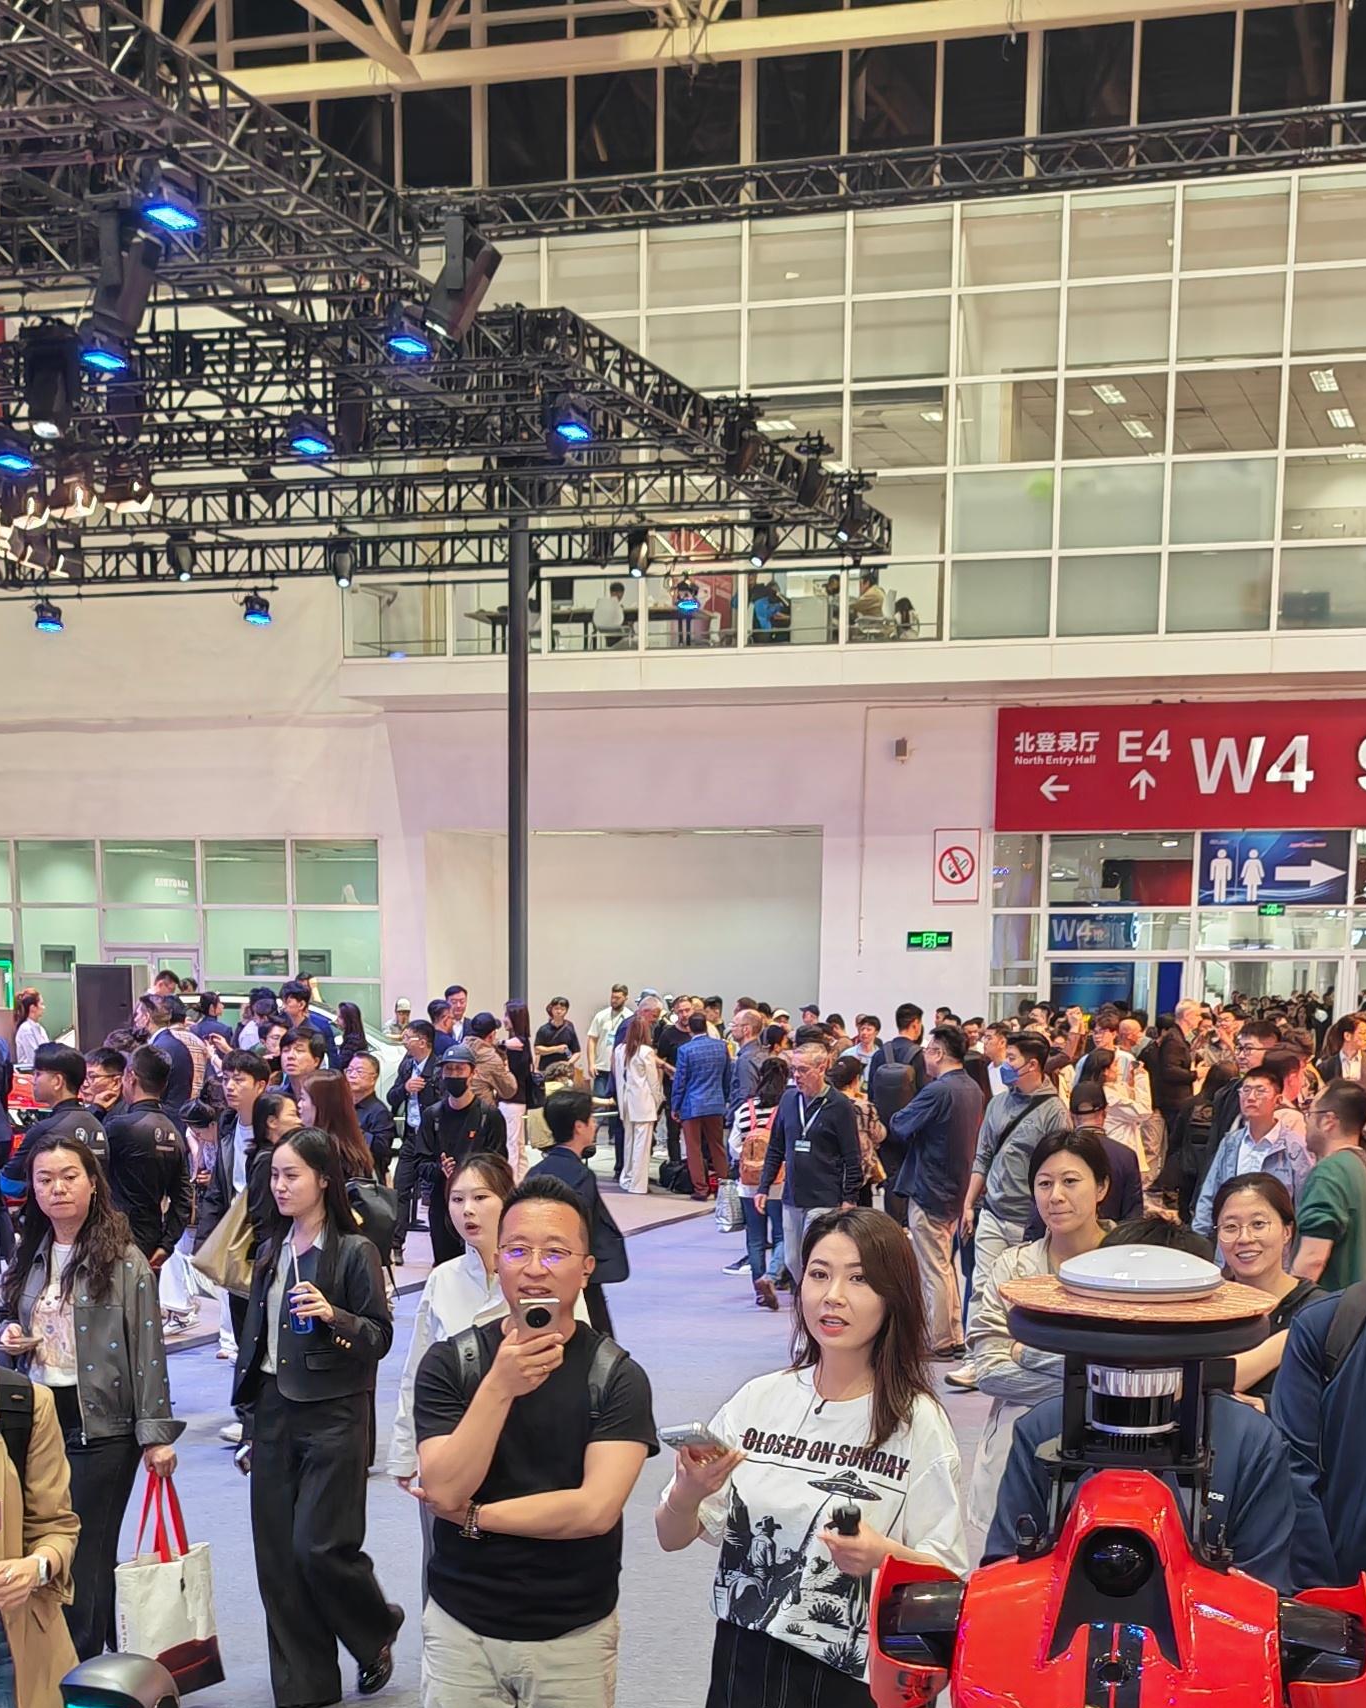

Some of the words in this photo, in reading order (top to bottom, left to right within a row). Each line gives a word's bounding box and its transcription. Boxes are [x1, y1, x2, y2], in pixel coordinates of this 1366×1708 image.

[1014, 731, 1100, 753] 北登录厅
[1118, 729, 1172, 763] E4
[1014, 755, 1044, 765] North
[1045, 755, 1074, 766] Entry
[1075, 754, 1096, 765] Hall
[1190, 734, 1314, 794] W4
[807, 1440, 836, 1465] ON
[835, 1444, 911, 1481] SUNDAY
